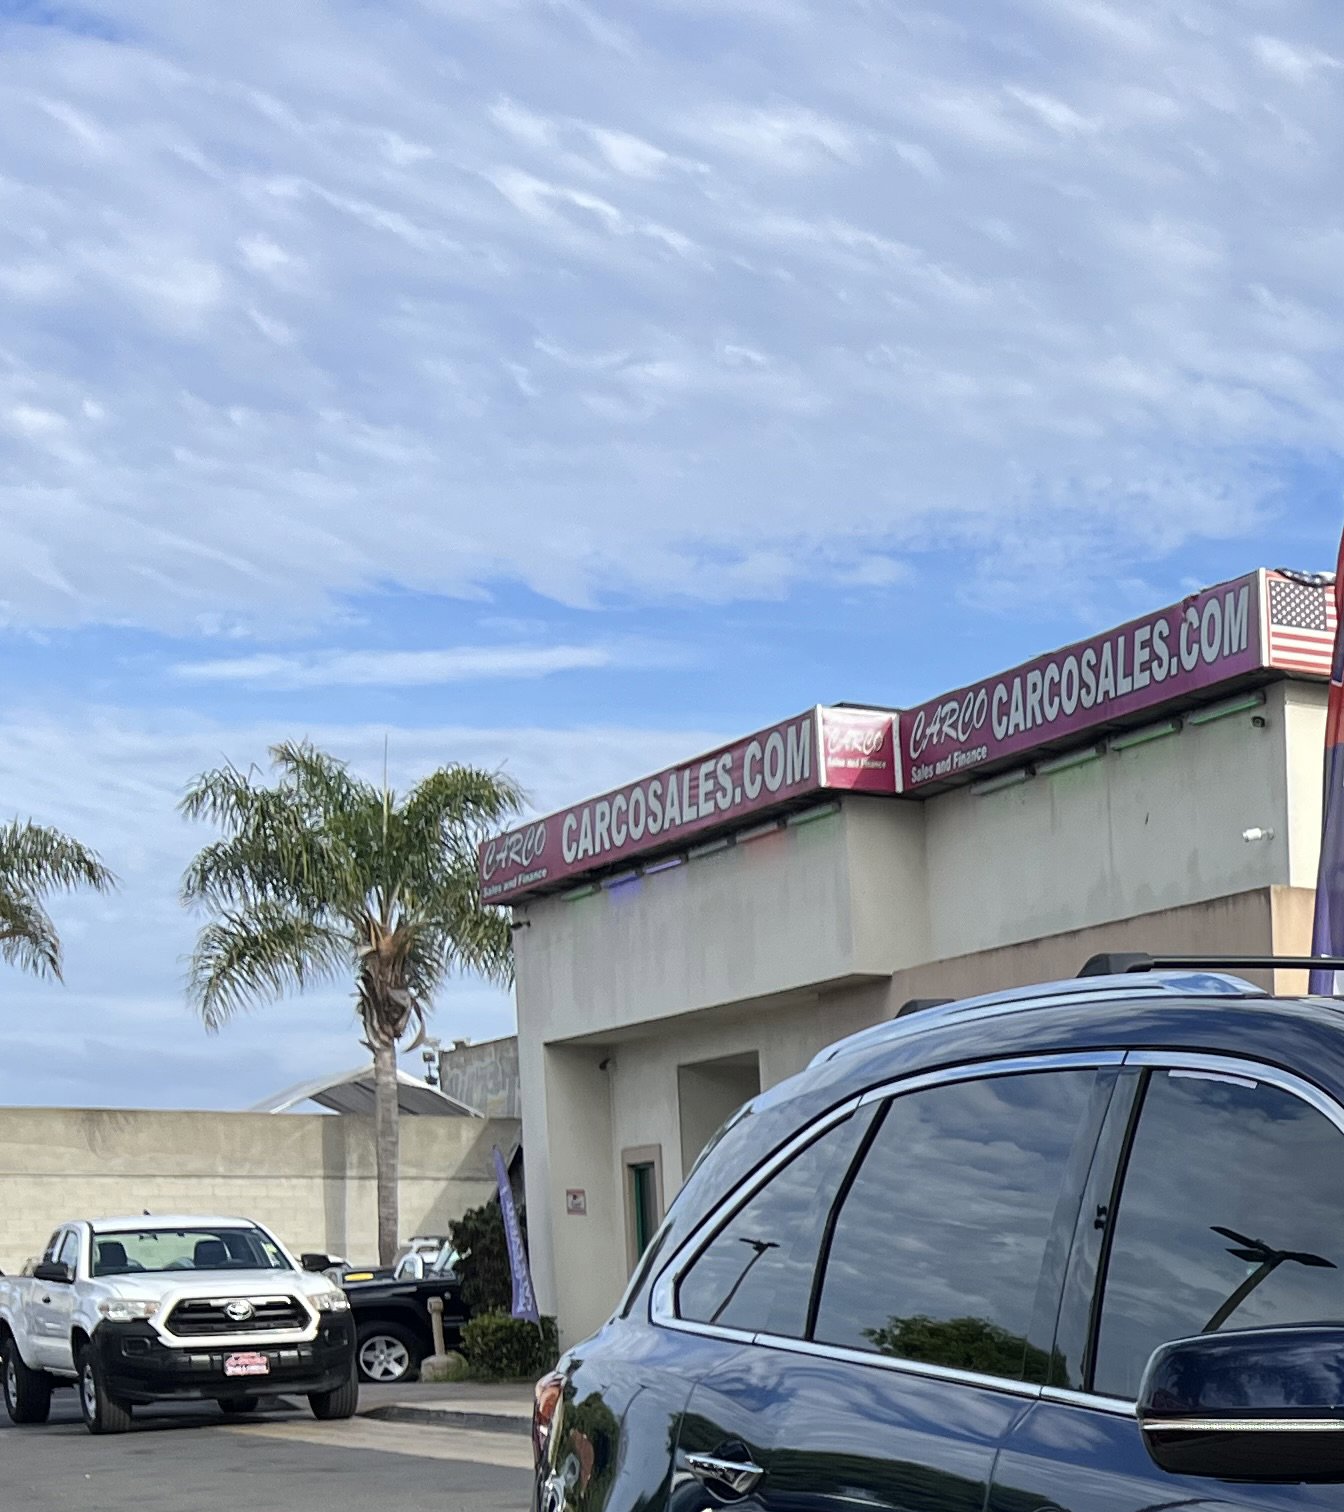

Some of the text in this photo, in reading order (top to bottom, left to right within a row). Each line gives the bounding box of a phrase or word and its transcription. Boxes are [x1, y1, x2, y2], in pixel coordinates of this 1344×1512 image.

[990, 585, 1250, 742] CARCOSALES.COM
[910, 687, 988, 760] CARCO
[561, 718, 812, 865] CARCOSALES.COM
[911, 745, 987, 783] Sales and Finance
[483, 822, 546, 880] CARCO
